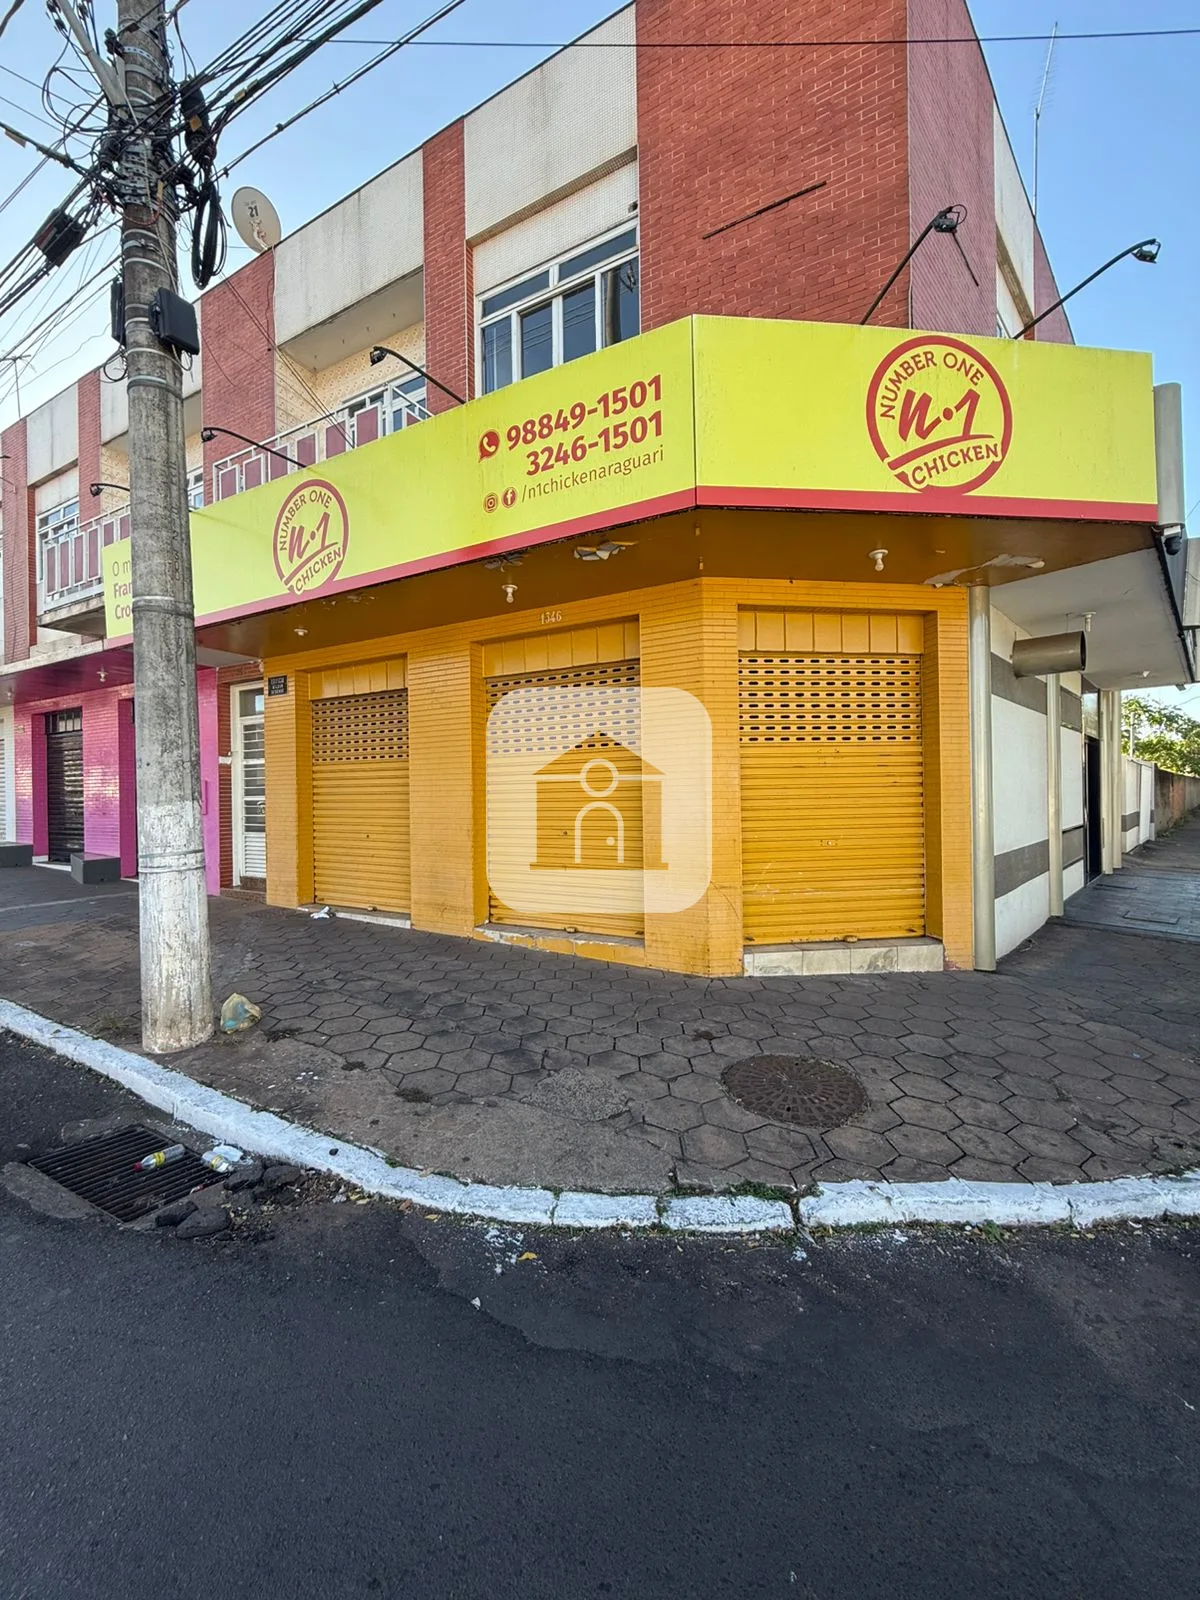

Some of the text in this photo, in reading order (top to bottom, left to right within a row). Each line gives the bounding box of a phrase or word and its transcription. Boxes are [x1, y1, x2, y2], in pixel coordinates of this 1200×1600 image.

[248, 205, 259, 218] 21
[506, 374, 662, 451] 98849-1501
[880, 350, 985, 420] NUMBER ONE
[526, 410, 662, 476] 3246-1501
[911, 443, 999, 485] CHICKEN
[279, 489, 332, 552] NUMBER ONE
[295, 547, 342, 592] CHICKEN
